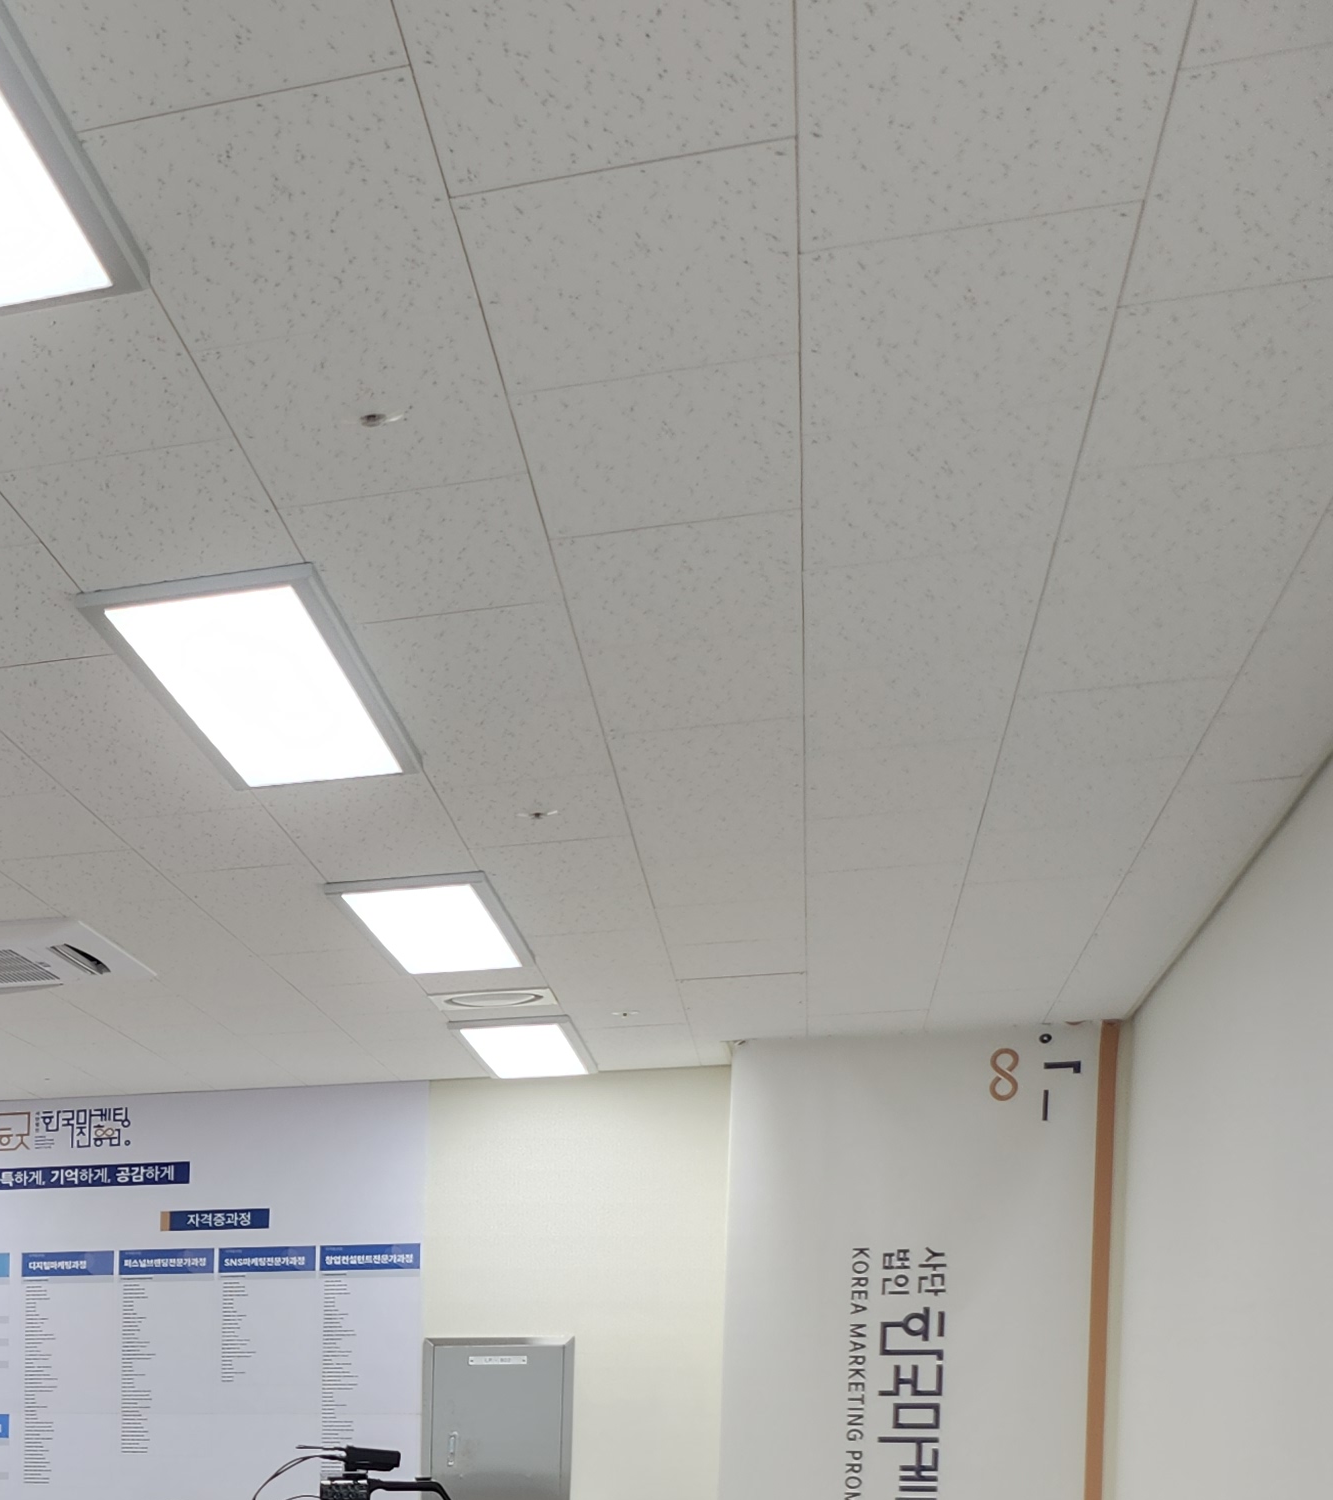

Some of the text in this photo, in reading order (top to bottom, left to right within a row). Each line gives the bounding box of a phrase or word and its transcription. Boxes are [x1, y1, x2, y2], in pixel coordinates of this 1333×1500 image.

[50, 1167, 111, 1185] 기억하게,
[115, 1164, 175, 1182] 공감하게
[186, 1211, 252, 1227] 자격증과정
[849, 1246, 871, 1316] KOREA
[881, 1247, 911, 1297] 법인
[917, 1246, 947, 1297] 사단
[846, 1322, 867, 1443] MARKETING
